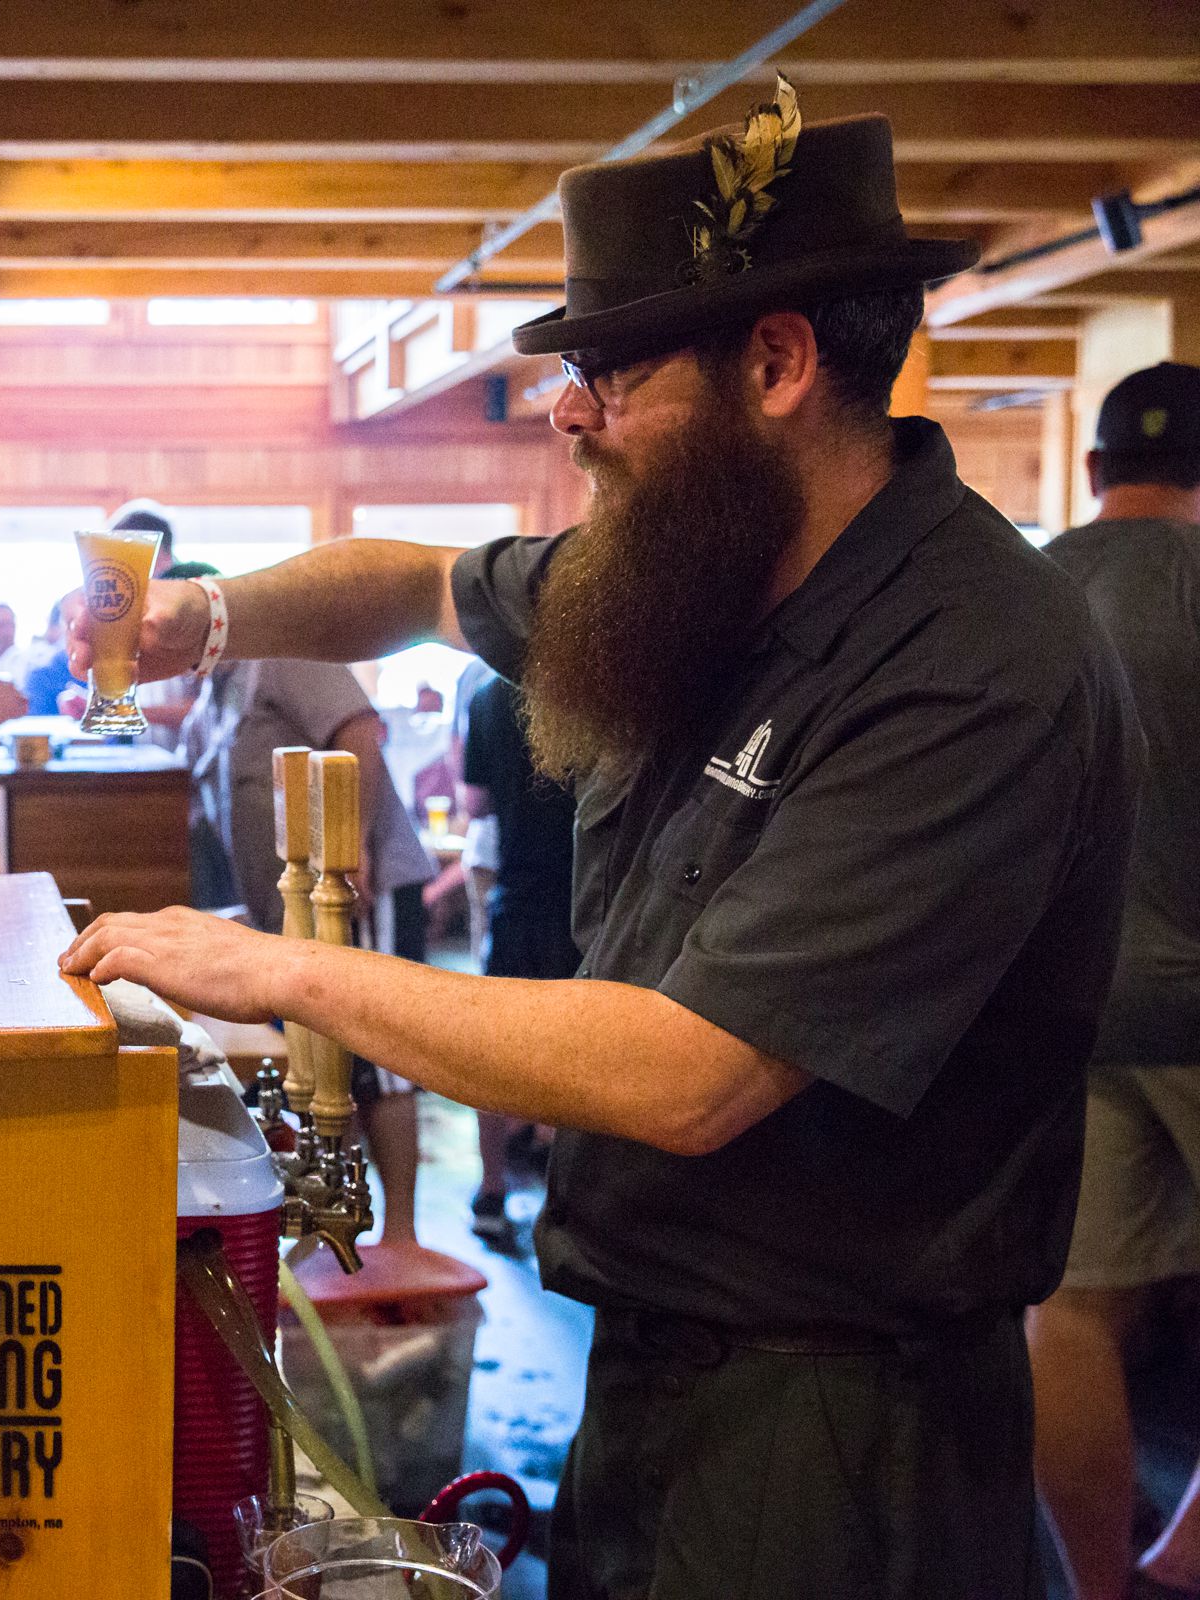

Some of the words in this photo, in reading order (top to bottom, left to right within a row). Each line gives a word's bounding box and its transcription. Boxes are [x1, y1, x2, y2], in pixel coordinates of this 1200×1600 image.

[95, 580, 117, 593] ON
[92, 593, 125, 608] TAP
[43, 1517, 64, 1529] ma
